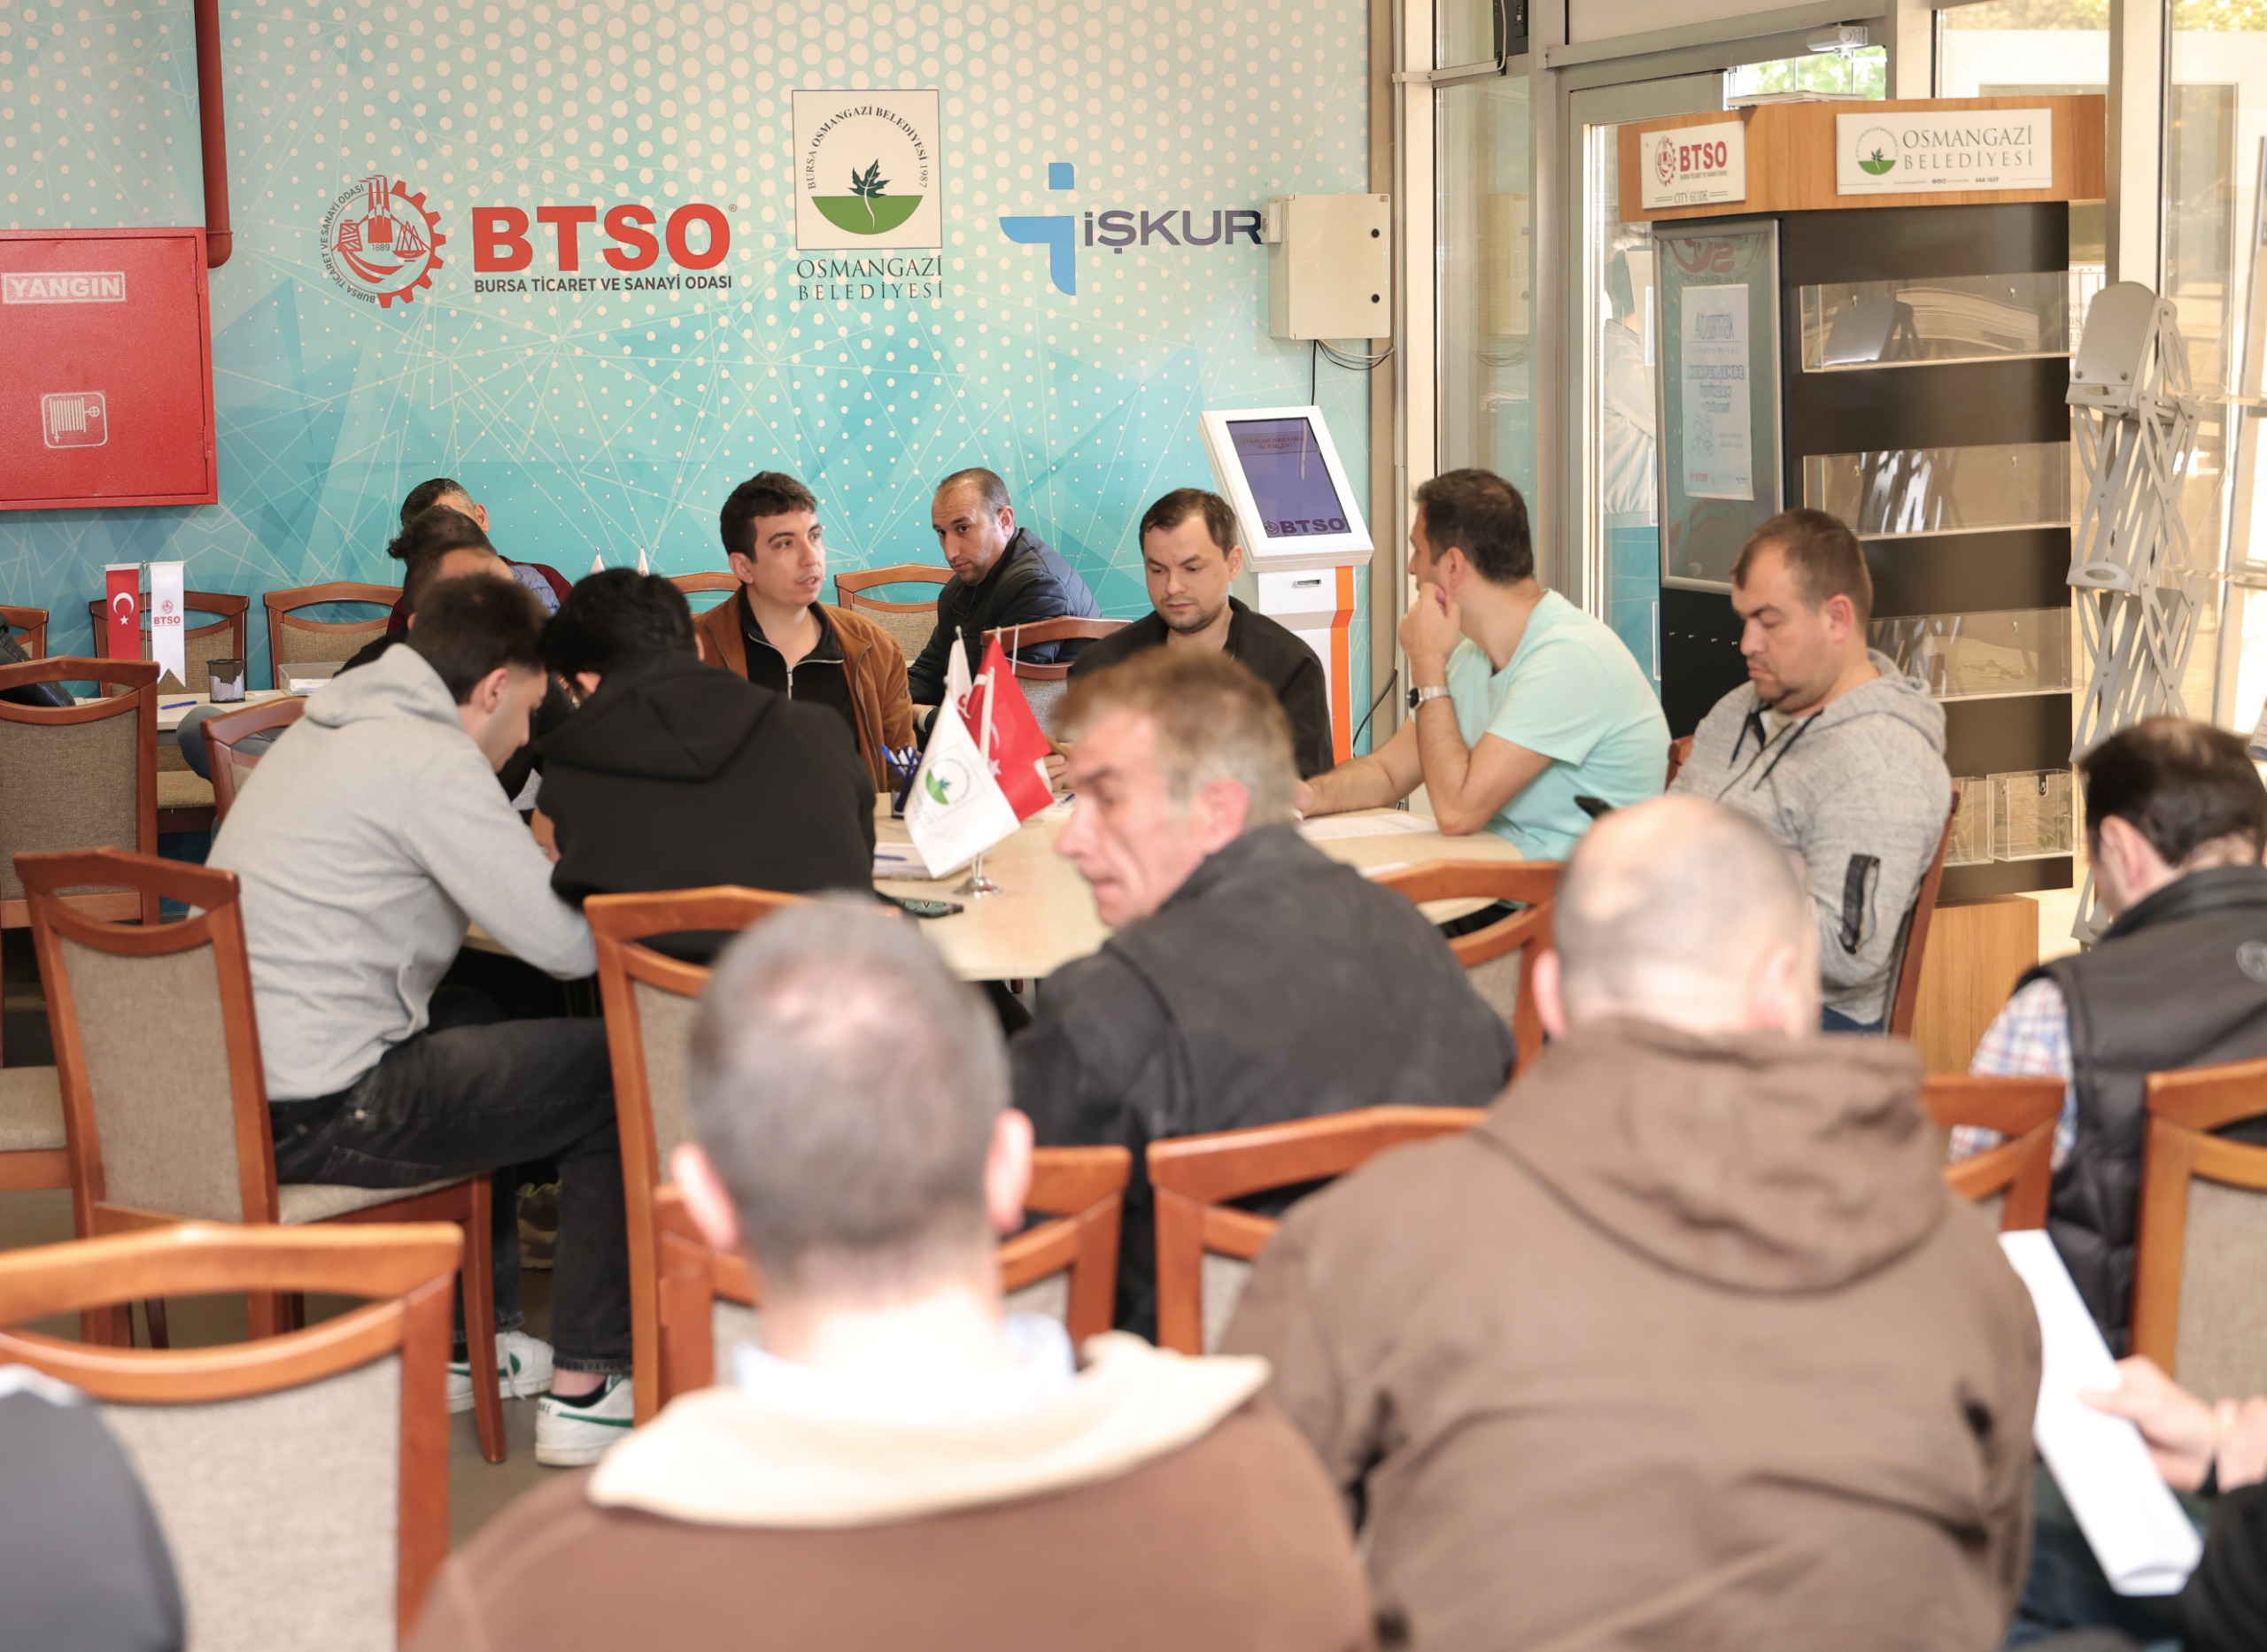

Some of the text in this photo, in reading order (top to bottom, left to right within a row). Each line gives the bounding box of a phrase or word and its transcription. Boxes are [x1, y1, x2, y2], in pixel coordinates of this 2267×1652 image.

[806, 104, 929, 189] BURSA OSMANGAZİ BELEDİYESİ 1987
[1903, 125, 2032, 149] OSMANGAZİ
[1680, 141, 1727, 172] BTSO
[1904, 149, 2032, 170] BELEDİYESİ
[321, 184, 375, 303] BURSA TİCARET VE SANAYİ ODASI
[371, 243, 391, 252] 1889
[472, 204, 731, 272] BTSO
[797, 255, 943, 279] OSMANGAZİ
[10, 277, 120, 298] YANGIN
[474, 274, 732, 293] BURSA TİCARET VE SANAYİ ODASI
[799, 282, 943, 301] BELEDİYESİ
[1279, 518, 1346, 534] BTSO
